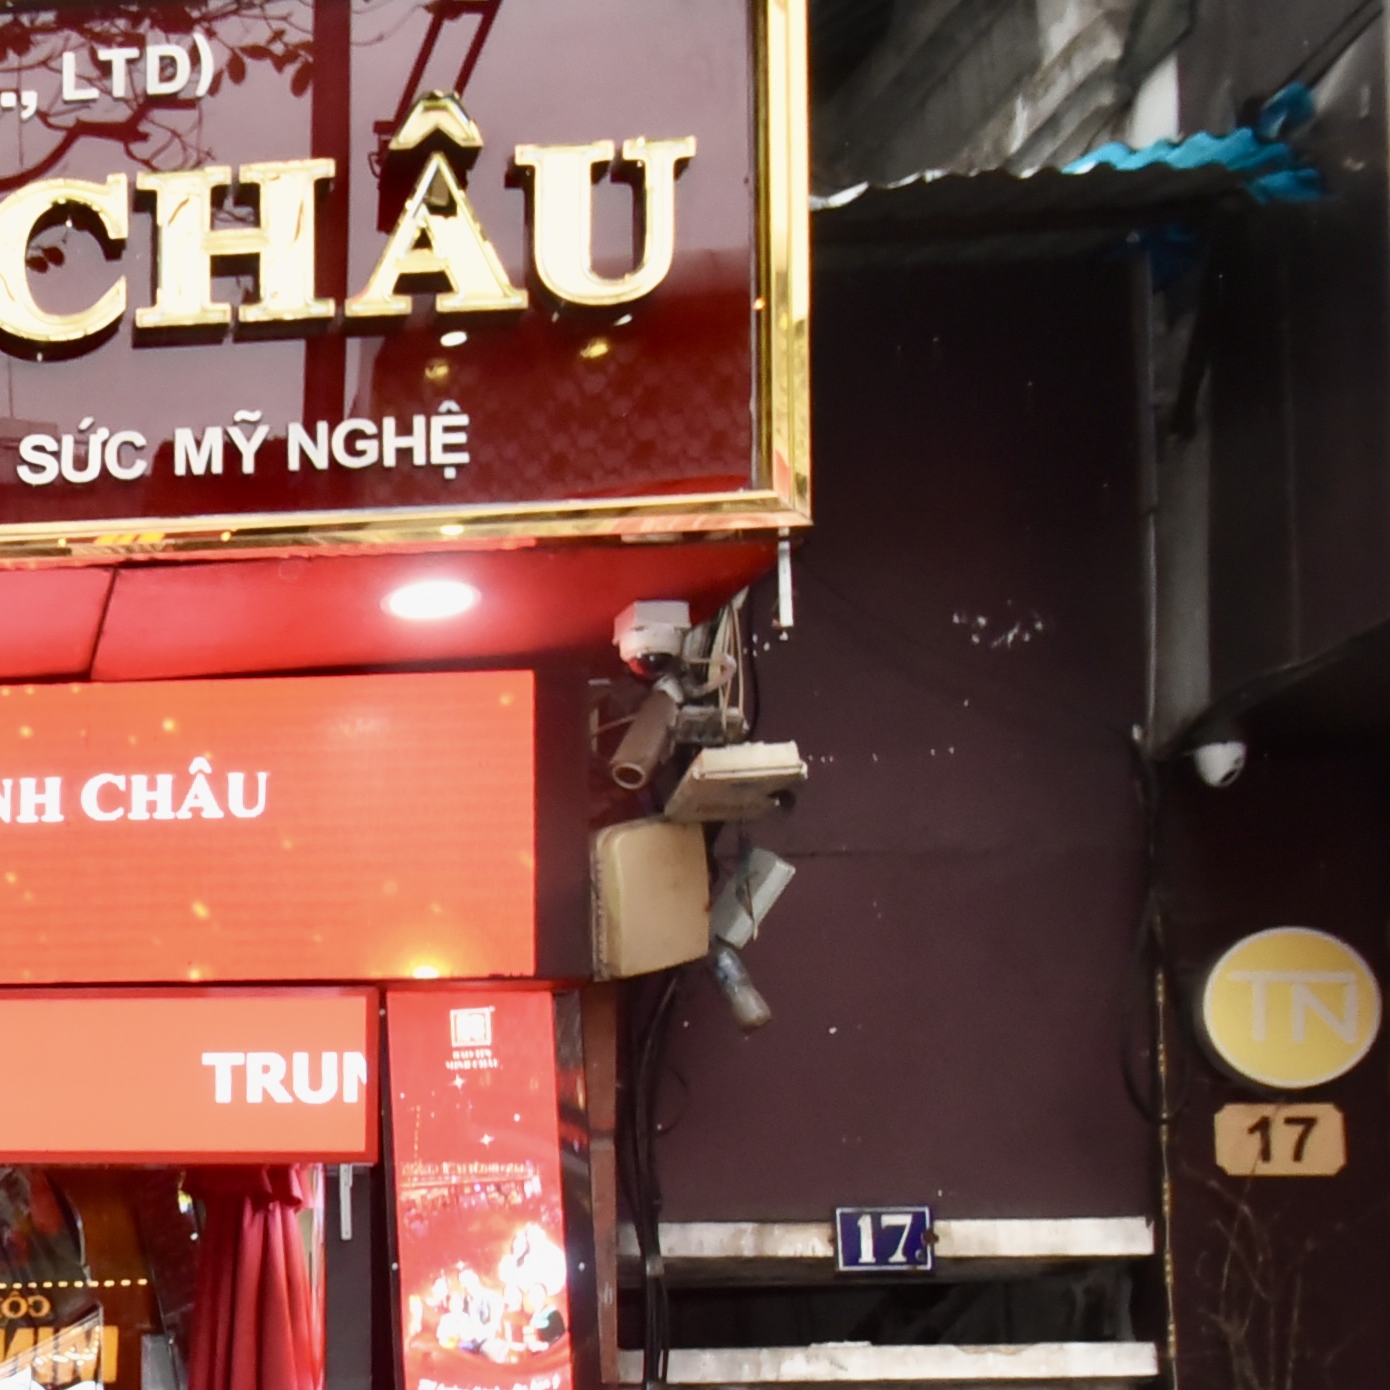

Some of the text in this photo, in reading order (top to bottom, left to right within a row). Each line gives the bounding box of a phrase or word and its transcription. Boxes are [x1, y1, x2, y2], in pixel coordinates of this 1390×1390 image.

[62, 32, 215, 102] LTD)
[17, 416, 149, 486] SỨC
[174, 408, 269, 477] MỸ
[287, 399, 472, 480] NGHỆ
[79, 756, 270, 823] CHÂU
[1227, 970, 1359, 1044] TN
[1247, 1116, 1318, 1163] 17
[857, 1213, 913, 1263] 17
